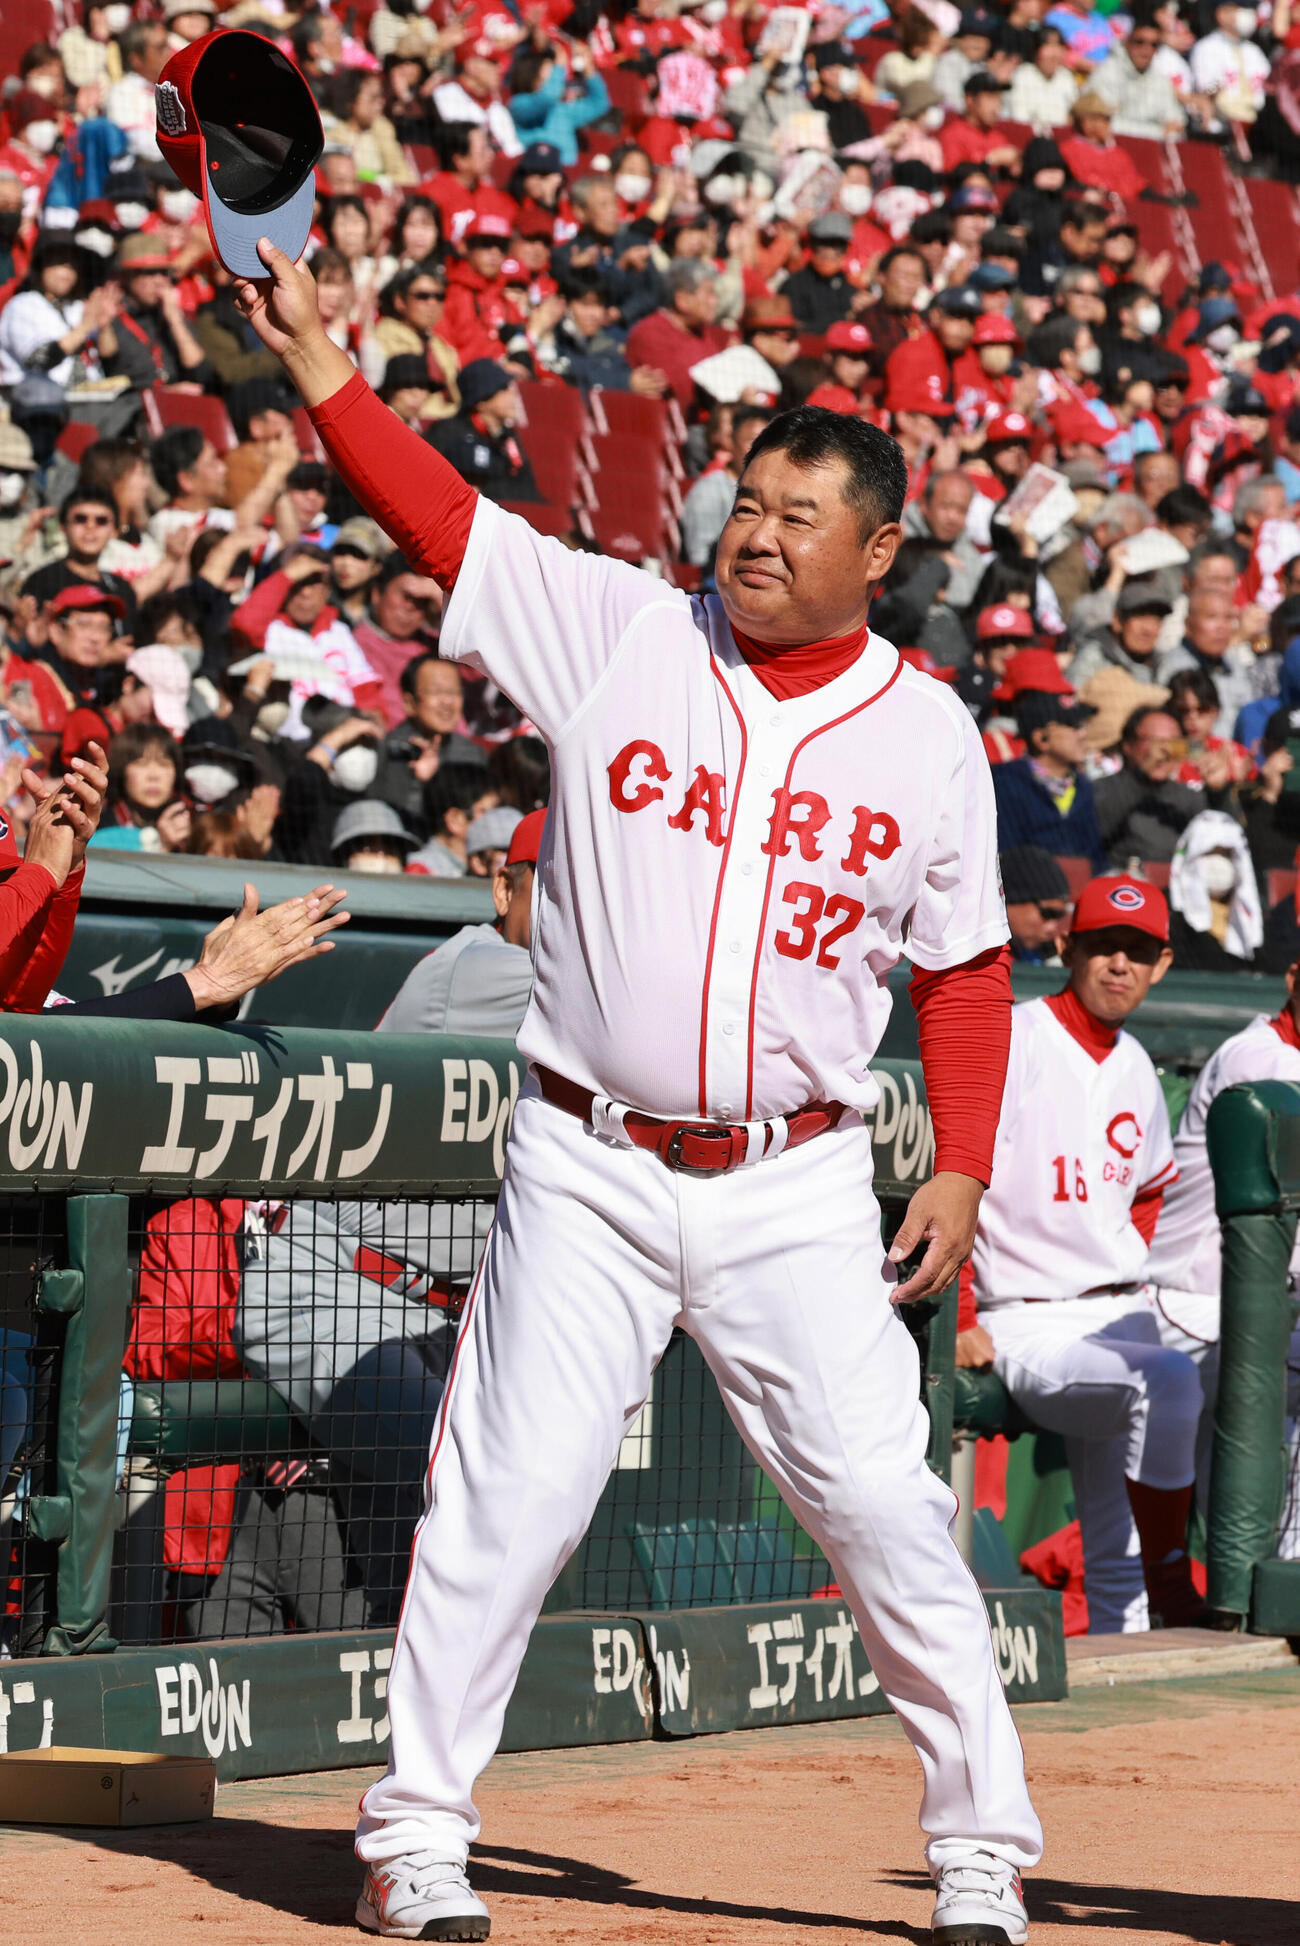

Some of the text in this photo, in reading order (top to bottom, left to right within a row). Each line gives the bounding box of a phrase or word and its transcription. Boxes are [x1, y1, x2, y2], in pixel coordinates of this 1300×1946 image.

[607, 739, 902, 876] CARP
[774, 881, 865, 970] 32
[139, 1051, 393, 1182] エディオン
[1052, 1155, 1088, 1202] 16
